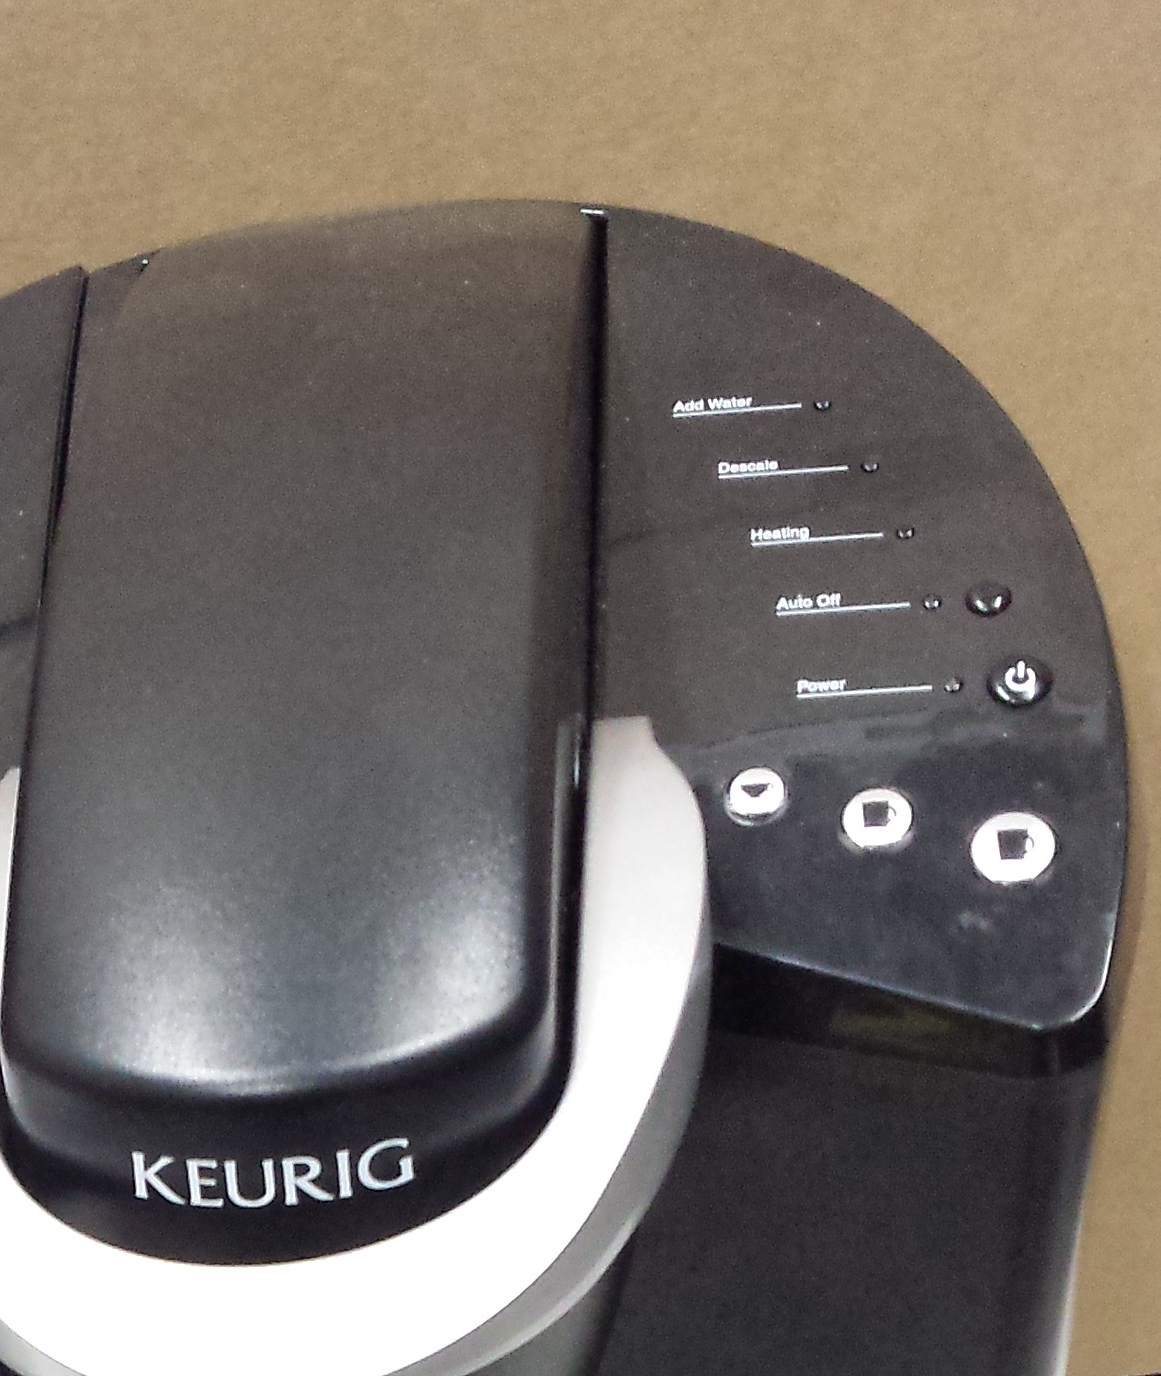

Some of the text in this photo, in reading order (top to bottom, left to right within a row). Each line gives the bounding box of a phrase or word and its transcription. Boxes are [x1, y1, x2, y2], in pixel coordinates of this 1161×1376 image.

[672, 396, 753, 413] Add Water
[717, 459, 779, 474] Descale
[750, 526, 810, 541] Heating
[776, 592, 841, 610] Auto Off
[797, 679, 846, 693] Power
[131, 1137, 415, 1208] KEURIG
